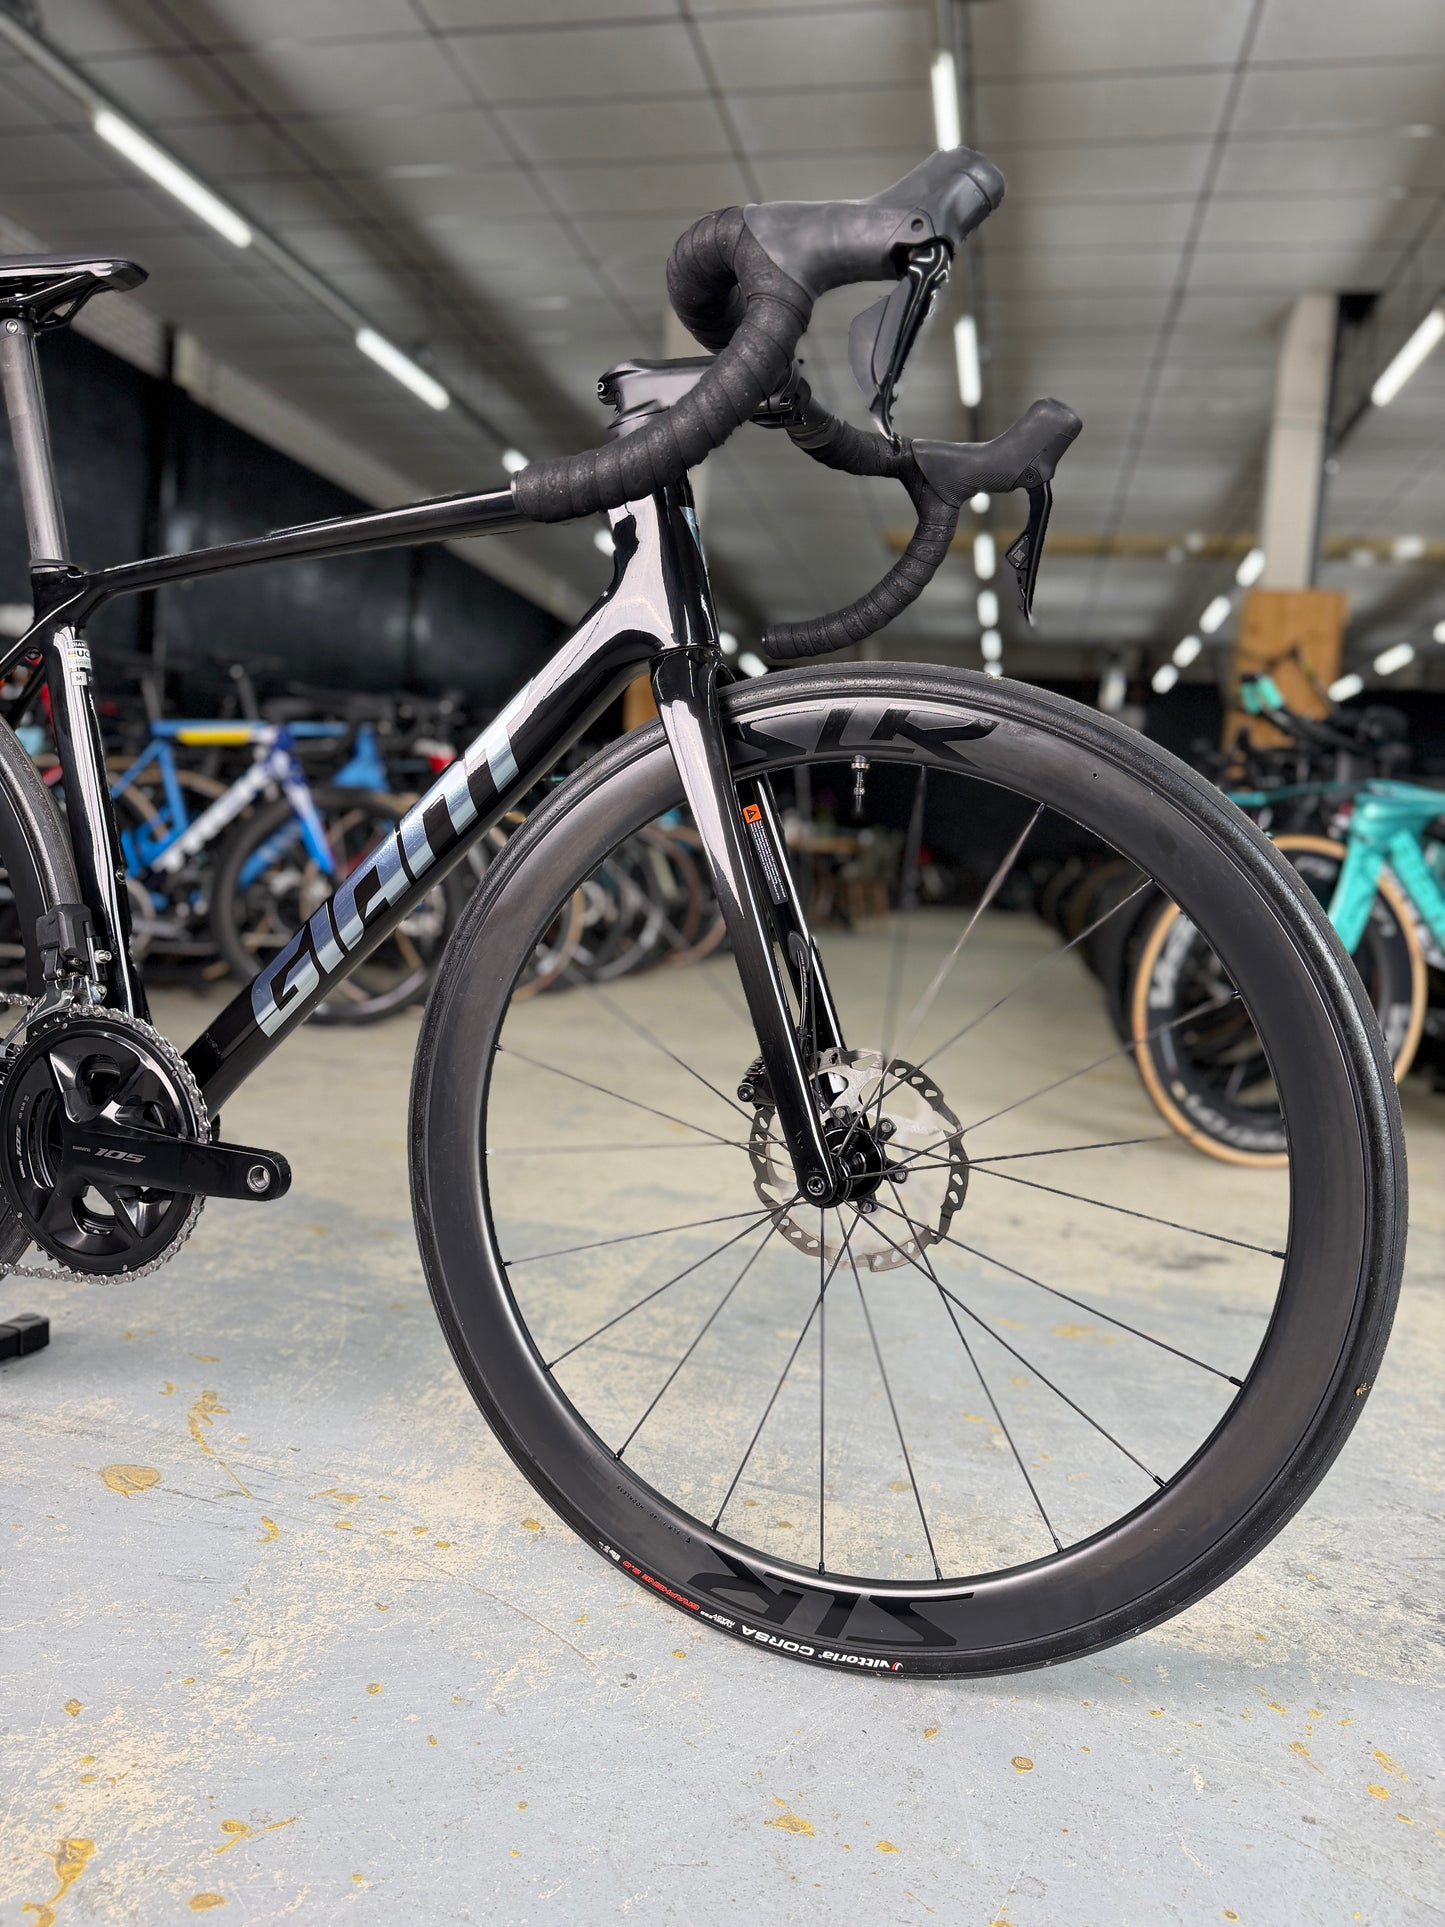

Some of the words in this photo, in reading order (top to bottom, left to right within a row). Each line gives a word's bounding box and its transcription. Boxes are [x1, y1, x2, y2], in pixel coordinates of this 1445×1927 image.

[724, 701, 1000, 771] SLR
[252, 677, 536, 1037] GIANT
[94, 1147, 147, 1164] 105
[616, 1485, 645, 1510] HOOKLESS
[687, 1543, 975, 1647] SLR
[741, 1624, 815, 1656] CORSA
[821, 1651, 891, 1669] vittoria
